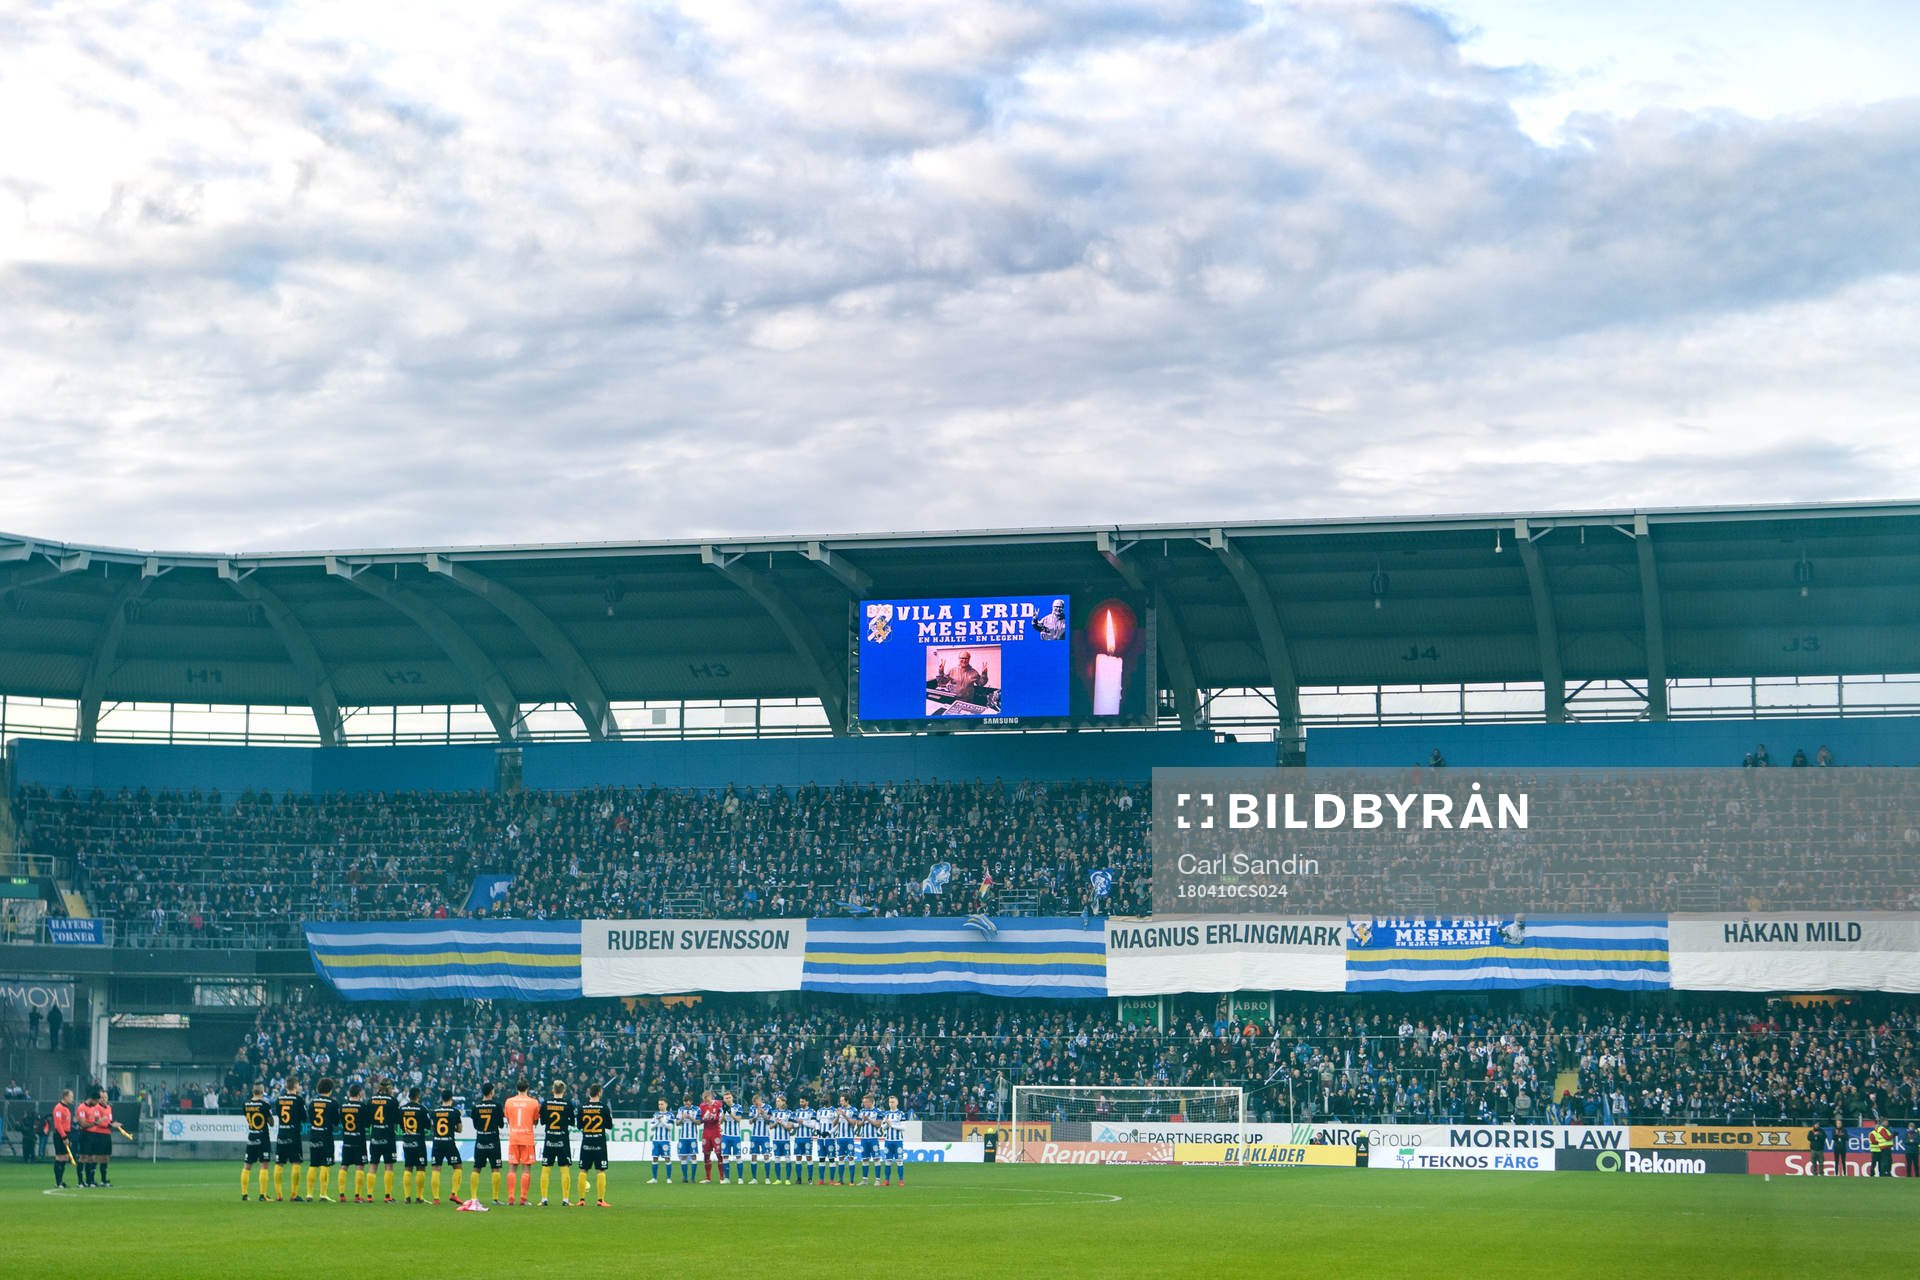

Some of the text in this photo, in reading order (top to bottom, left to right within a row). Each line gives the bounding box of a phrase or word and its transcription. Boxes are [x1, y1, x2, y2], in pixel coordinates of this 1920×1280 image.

[896, 605, 953, 621] VILA
[963, 604, 971, 619] I
[980, 603, 1034, 619] FRID
[917, 619, 1025, 636] MESKEN!
[990, 634, 1024, 642] LEGEND
[187, 668, 222, 683] H1
[688, 662, 731, 678] H3
[983, 717, 1019, 725] SAMSUNG
[51, 919, 94, 929] HATERS
[1724, 918, 1862, 943] HÅKAN MILD
[608, 929, 790, 950] RUBEN SVENSSON
[1110, 923, 1342, 949] MAGNUS ERLINGMARK
[1395, 928, 1491, 942] MESKEN!
[281, 1106, 291, 1124] 5
[313, 1108, 324, 1127] 3
[344, 1113, 356, 1132] 8
[374, 1105, 384, 1124] 4
[480, 1114, 492, 1132] 7
[549, 1111, 561, 1130] 2
[436, 1117, 449, 1136] 6
[582, 1115, 604, 1133] 22
[1367, 1129, 1422, 1147] Group
[1450, 1129, 1623, 1149] MORRIS LAW
[1691, 1132, 1754, 1144] HECO
[1040, 1143, 1128, 1164] Renova
[1418, 1153, 1539, 1169] TEKNOS FÄRG
[1624, 1151, 1706, 1174] Rekomo
